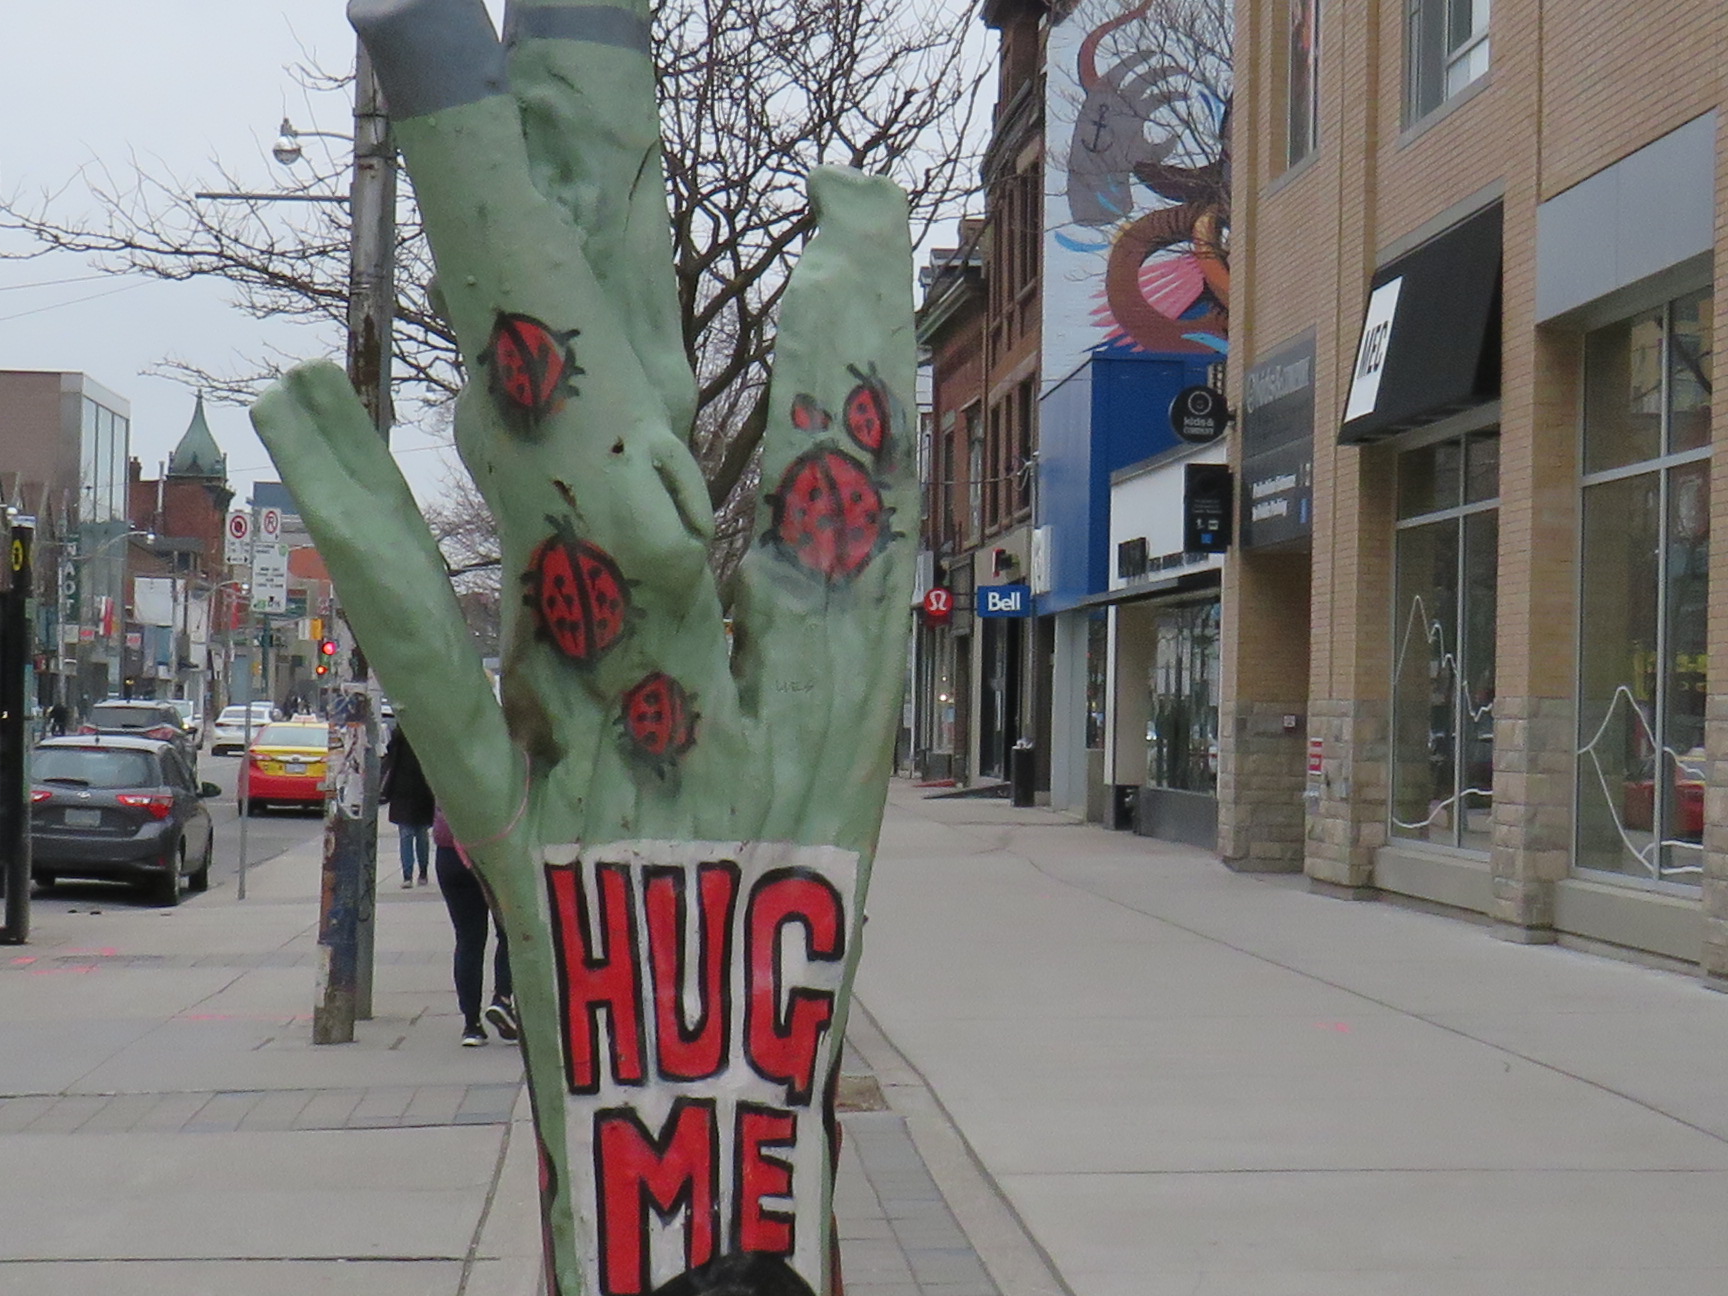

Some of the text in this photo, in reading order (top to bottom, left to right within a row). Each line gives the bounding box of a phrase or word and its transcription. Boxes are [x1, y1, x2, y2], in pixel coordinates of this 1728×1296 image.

[1356, 320, 1389, 380] MEC
[987, 591, 1021, 612] Bell
[544, 860, 846, 1106] HUG
